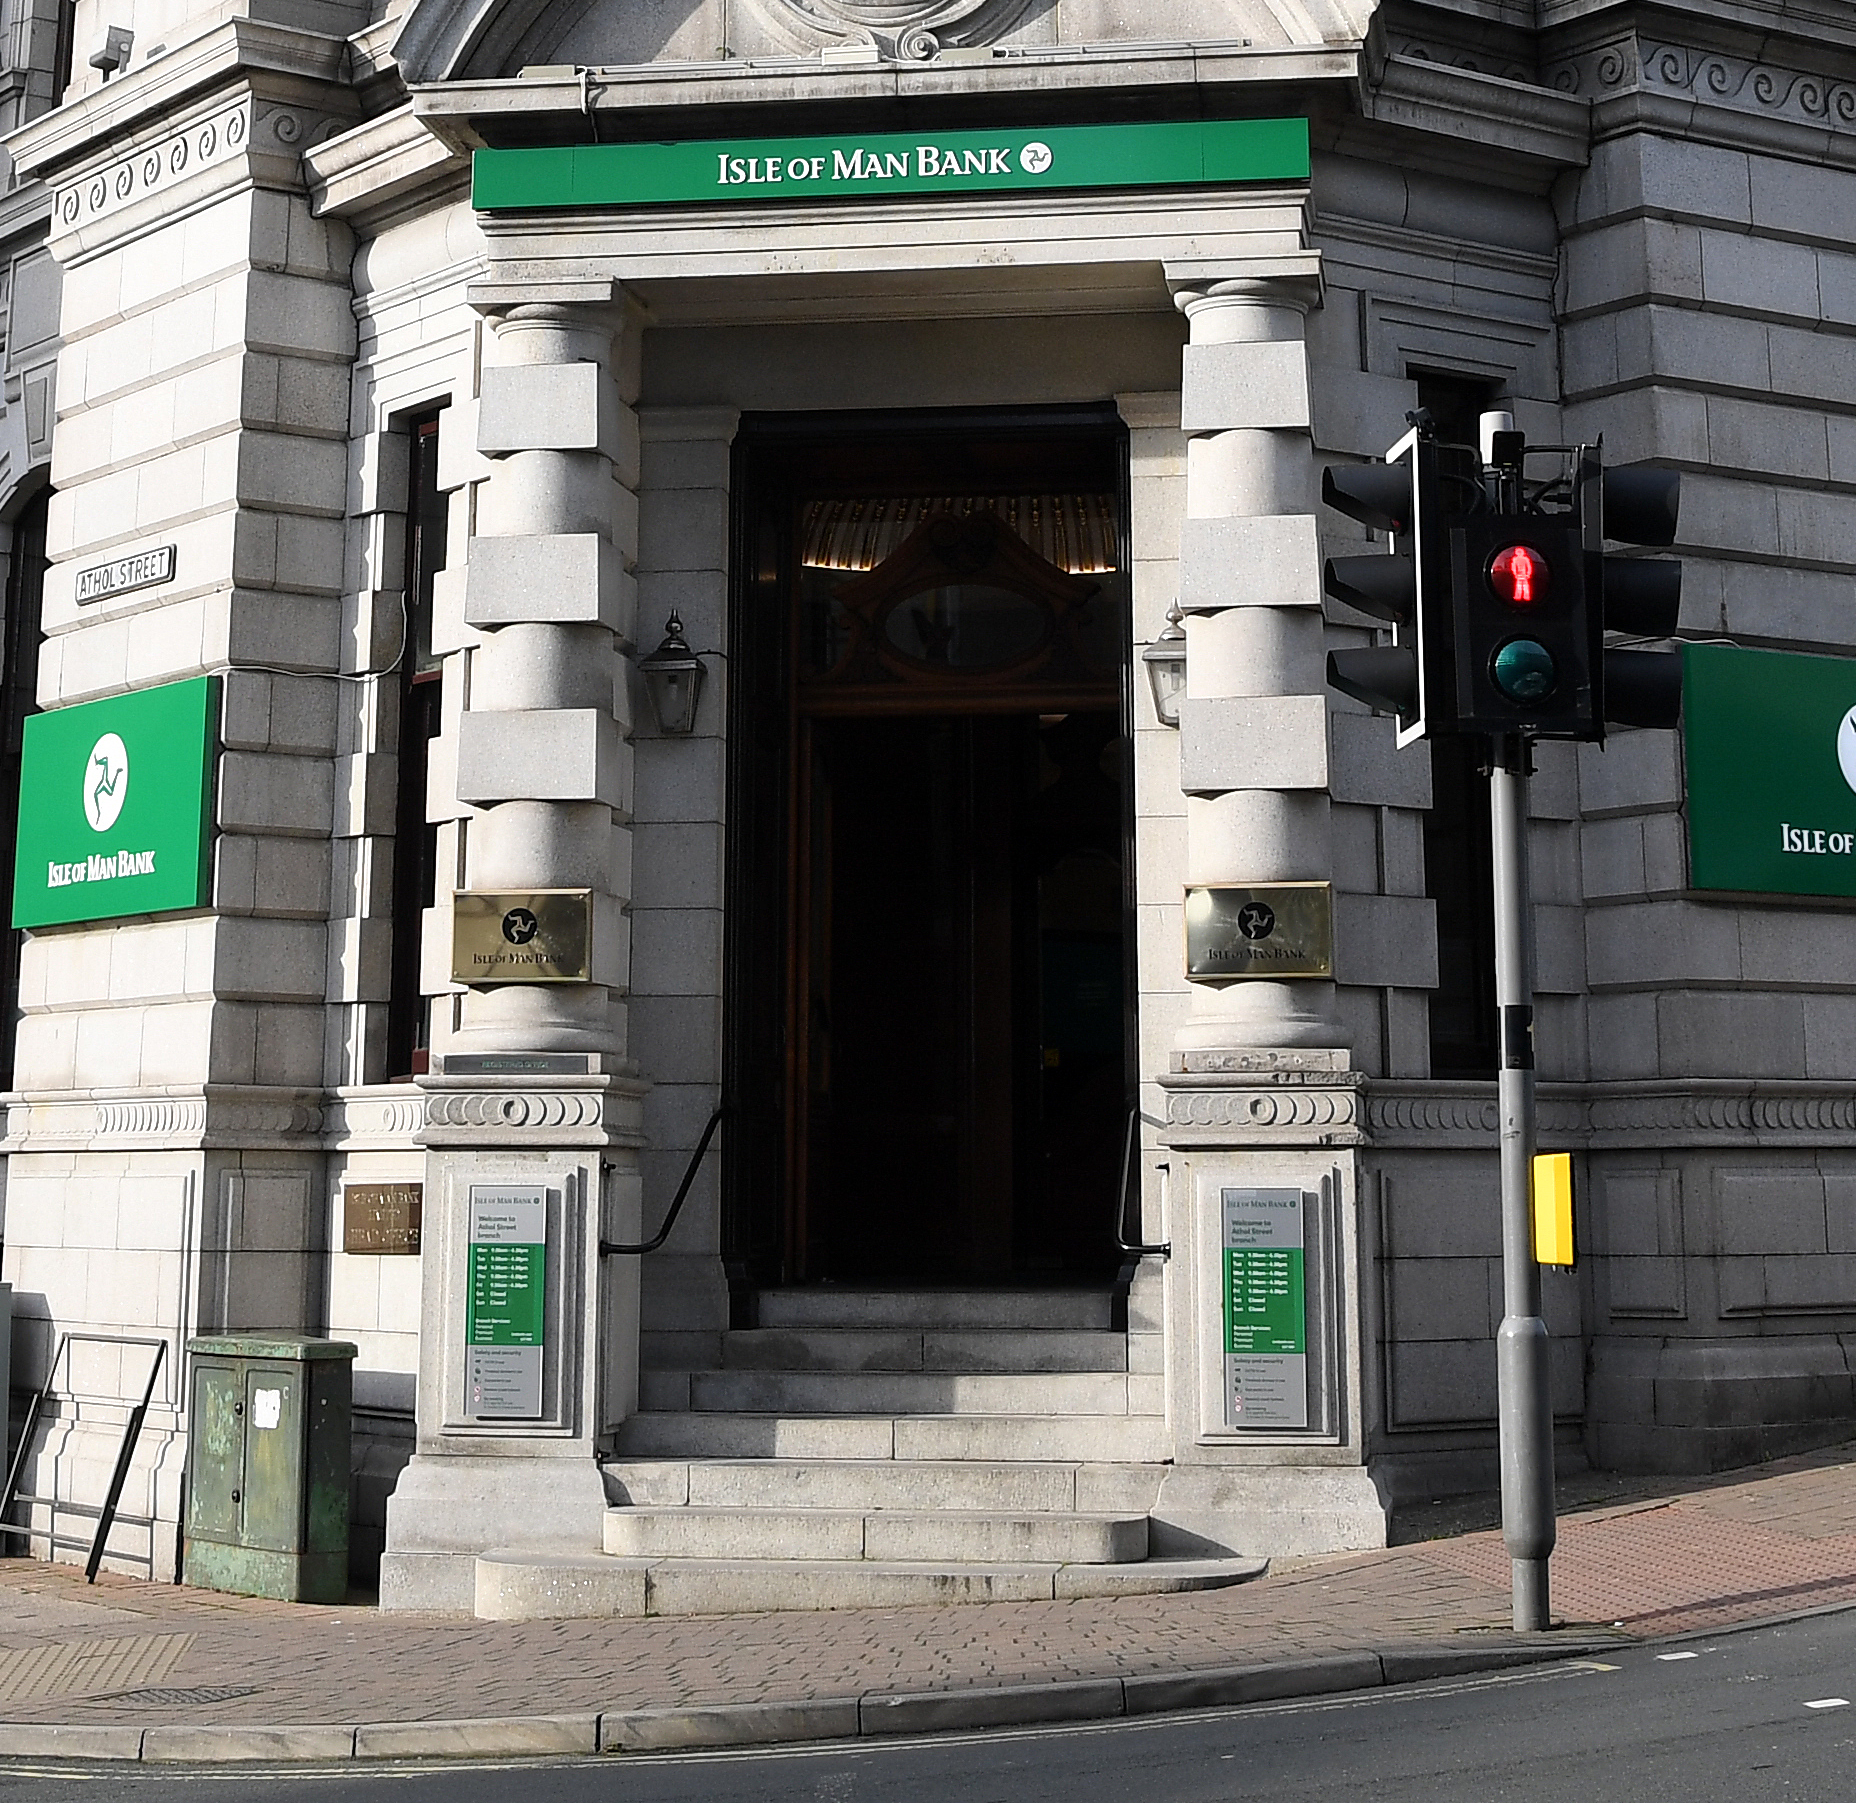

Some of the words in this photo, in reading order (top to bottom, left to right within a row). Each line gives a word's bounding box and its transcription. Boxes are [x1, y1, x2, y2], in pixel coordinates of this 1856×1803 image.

[717, 153, 783, 184] ISLE
[787, 157, 825, 180] OF
[831, 149, 909, 179] MAN
[916, 146, 1011, 177] BANK
[80, 567, 115, 597] ATHOL
[120, 552, 165, 585] STREET
[1780, 823, 1827, 854] ISLE
[1828, 833, 1855, 854] OF
[47, 861, 72, 888] ISLE
[71, 862, 87, 883] OF
[87, 854, 117, 882] MAN
[117, 848, 155, 878] BANK
[473, 953, 495, 964] ISLE
[509, 953, 532, 964] MAN
[535, 953, 563, 964] BANK
[1208, 948, 1231, 960] ISLE
[1246, 949, 1272, 959] MAN
[1275, 949, 1305, 959] BANK
